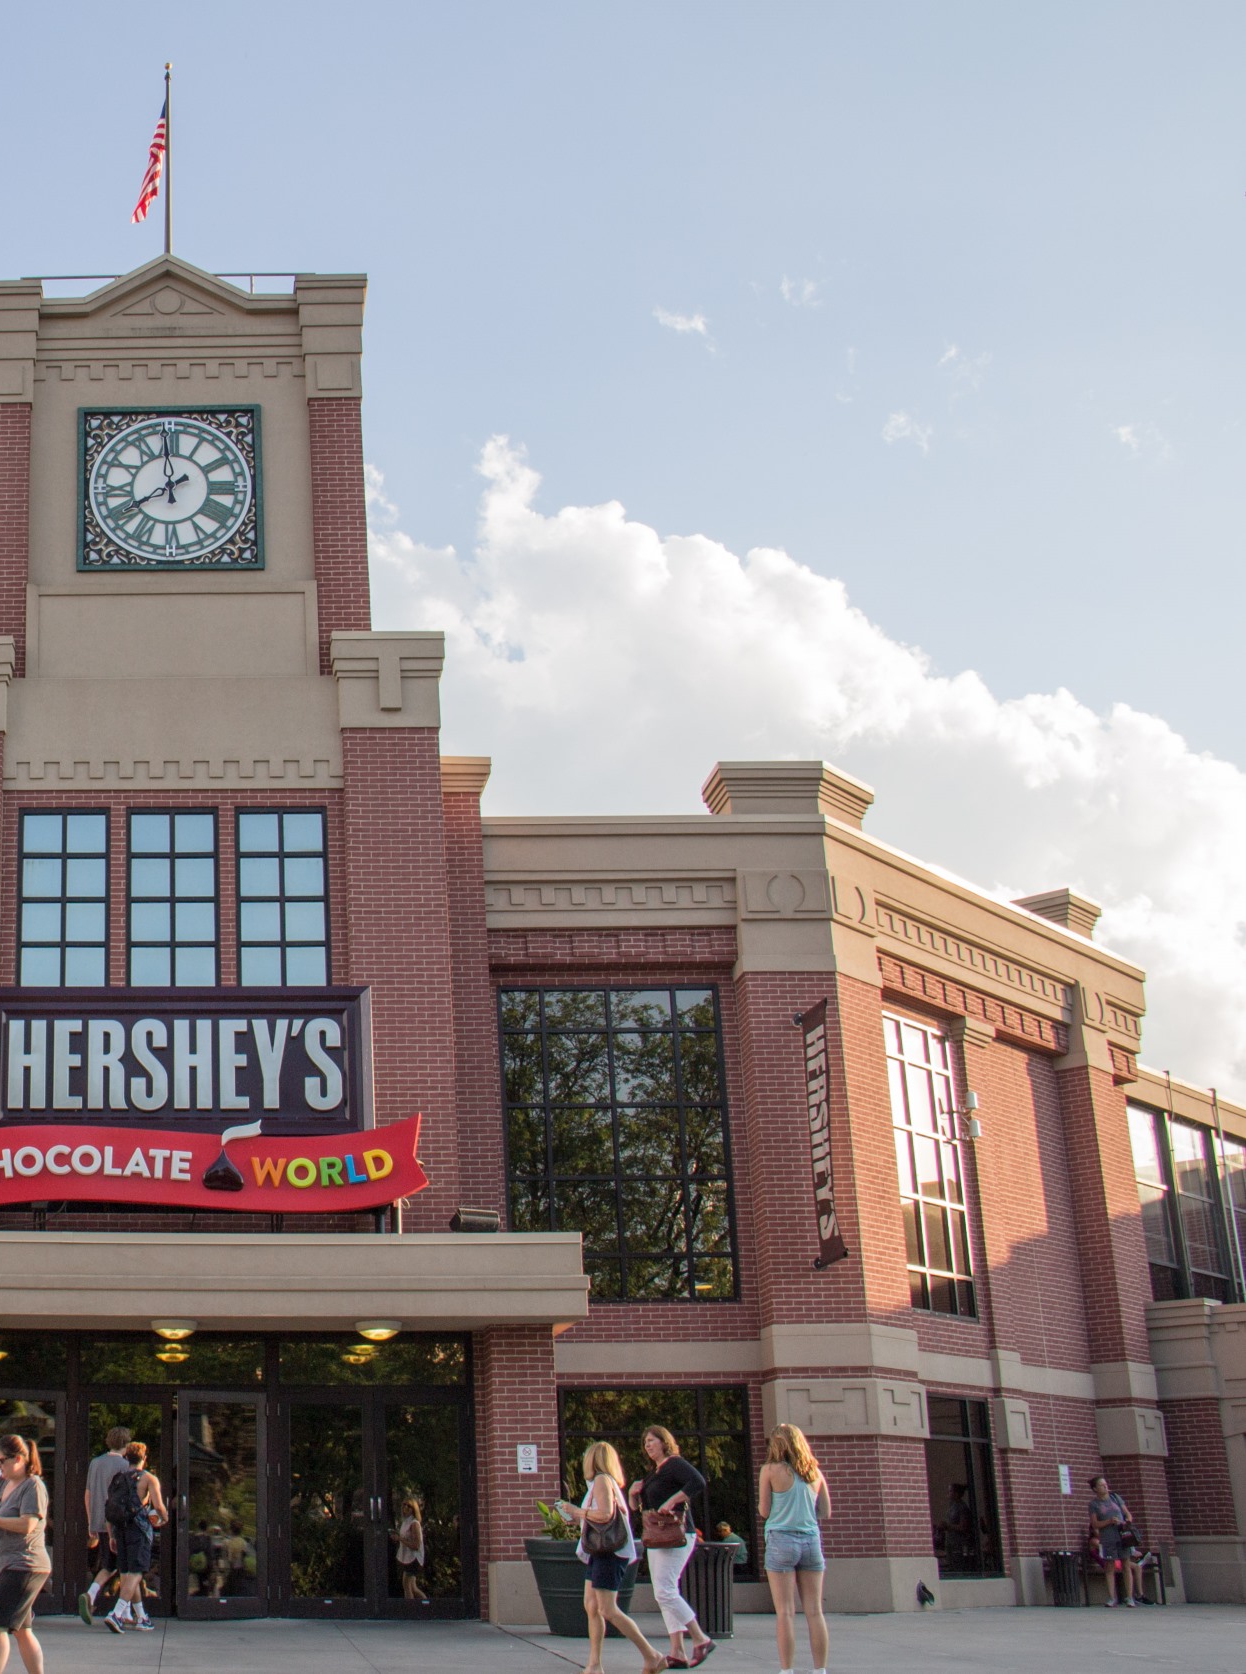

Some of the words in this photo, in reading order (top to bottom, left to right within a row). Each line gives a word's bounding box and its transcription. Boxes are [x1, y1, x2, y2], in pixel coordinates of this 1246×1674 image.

[108, 455, 142, 478] X
[7, 1017, 344, 1111] HERSHEY'S
[805, 1023, 839, 1241] HERSHEY'S
[251, 1148, 394, 1188] WORLD
